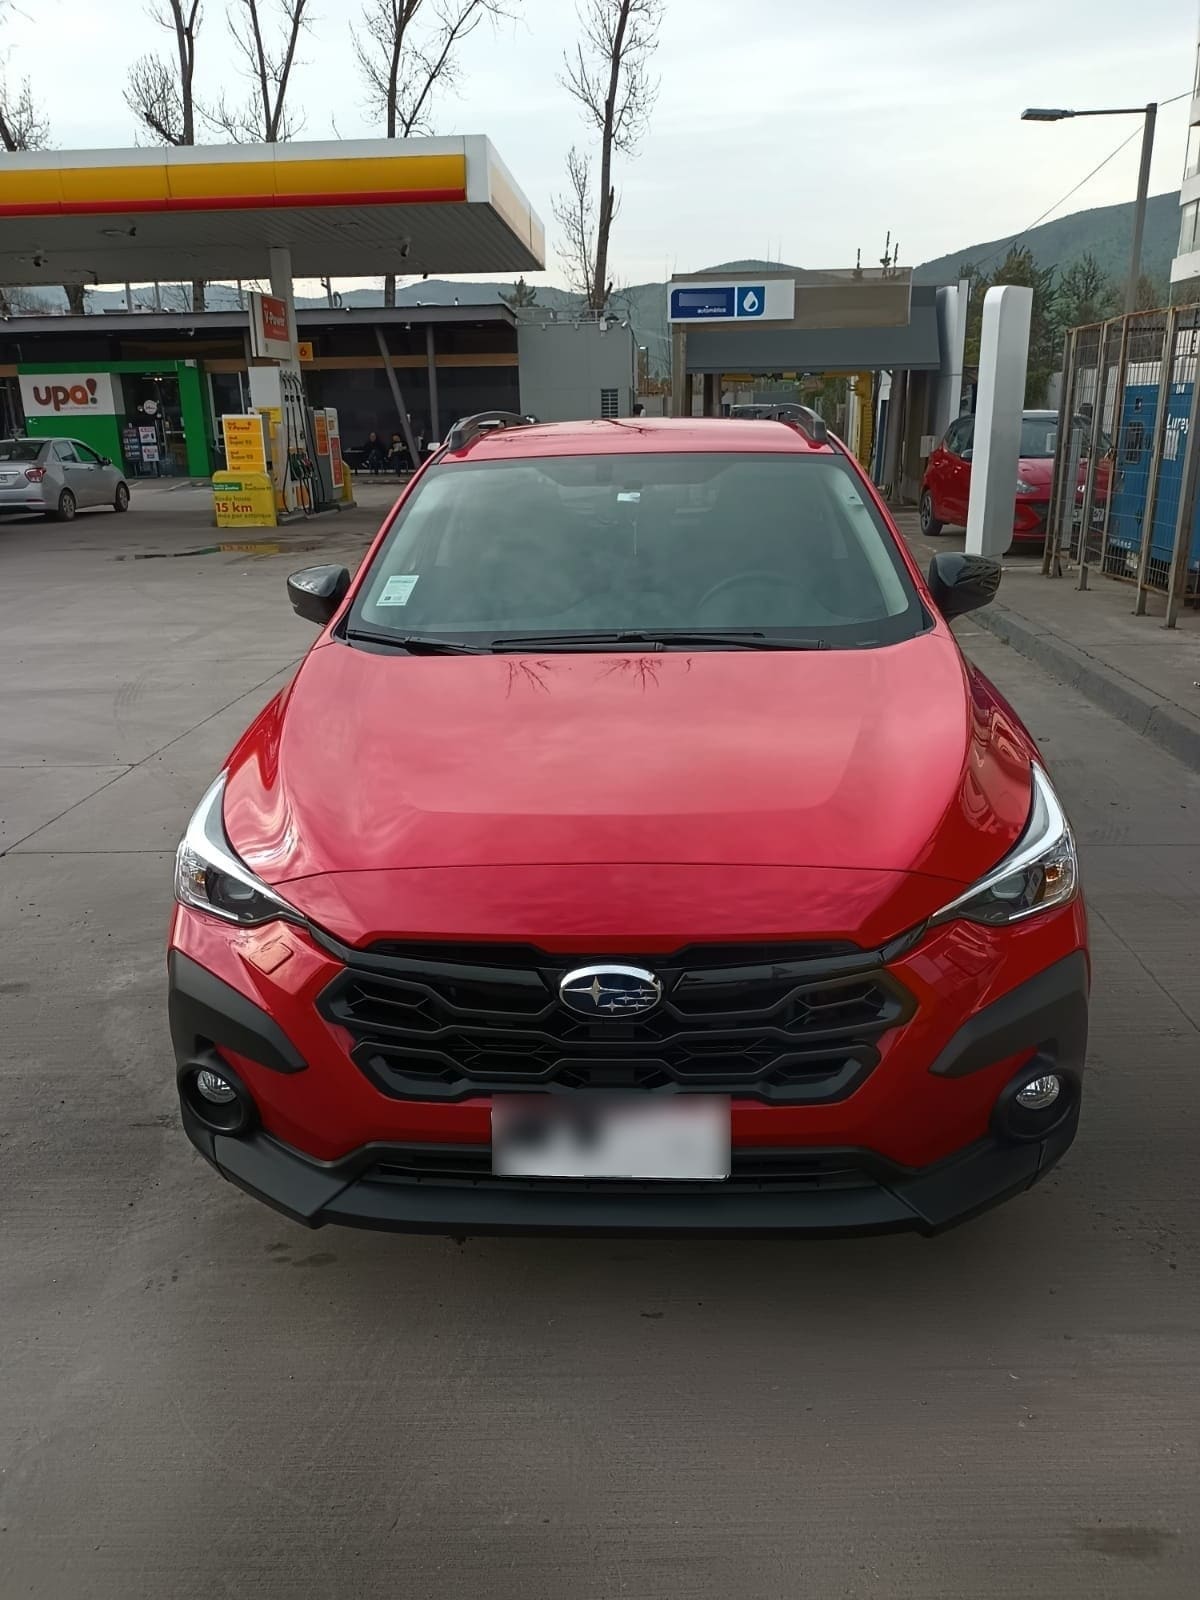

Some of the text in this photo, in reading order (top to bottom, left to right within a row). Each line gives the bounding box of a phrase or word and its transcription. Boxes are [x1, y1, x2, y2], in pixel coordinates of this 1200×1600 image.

[33, 378, 97, 412] upa!
[216, 501, 253, 513] 15 km
